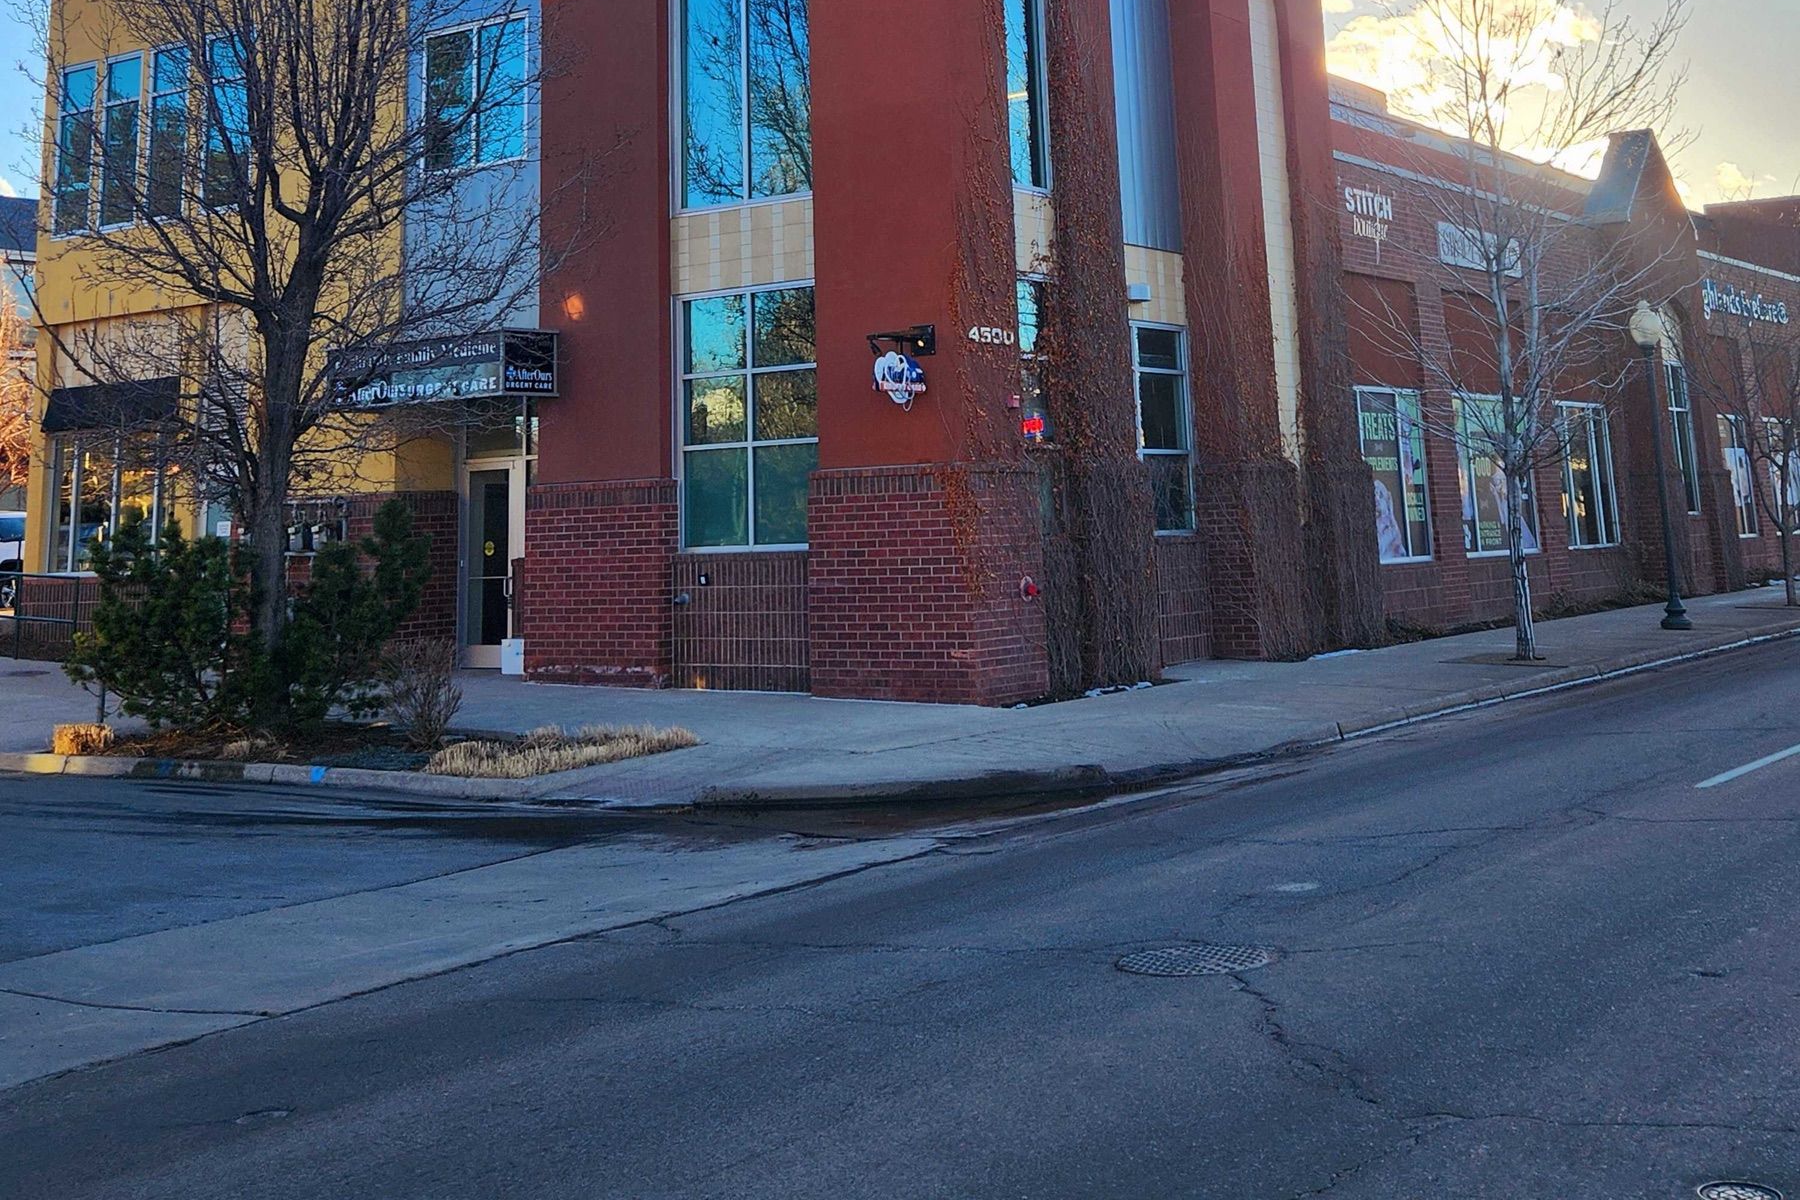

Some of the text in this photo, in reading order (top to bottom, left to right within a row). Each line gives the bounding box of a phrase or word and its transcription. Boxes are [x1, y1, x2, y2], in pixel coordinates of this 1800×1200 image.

[1344, 186, 1393, 221] STITCH
[461, 376, 497, 392] CARE
[505, 381, 552, 390] URGENT CARE
